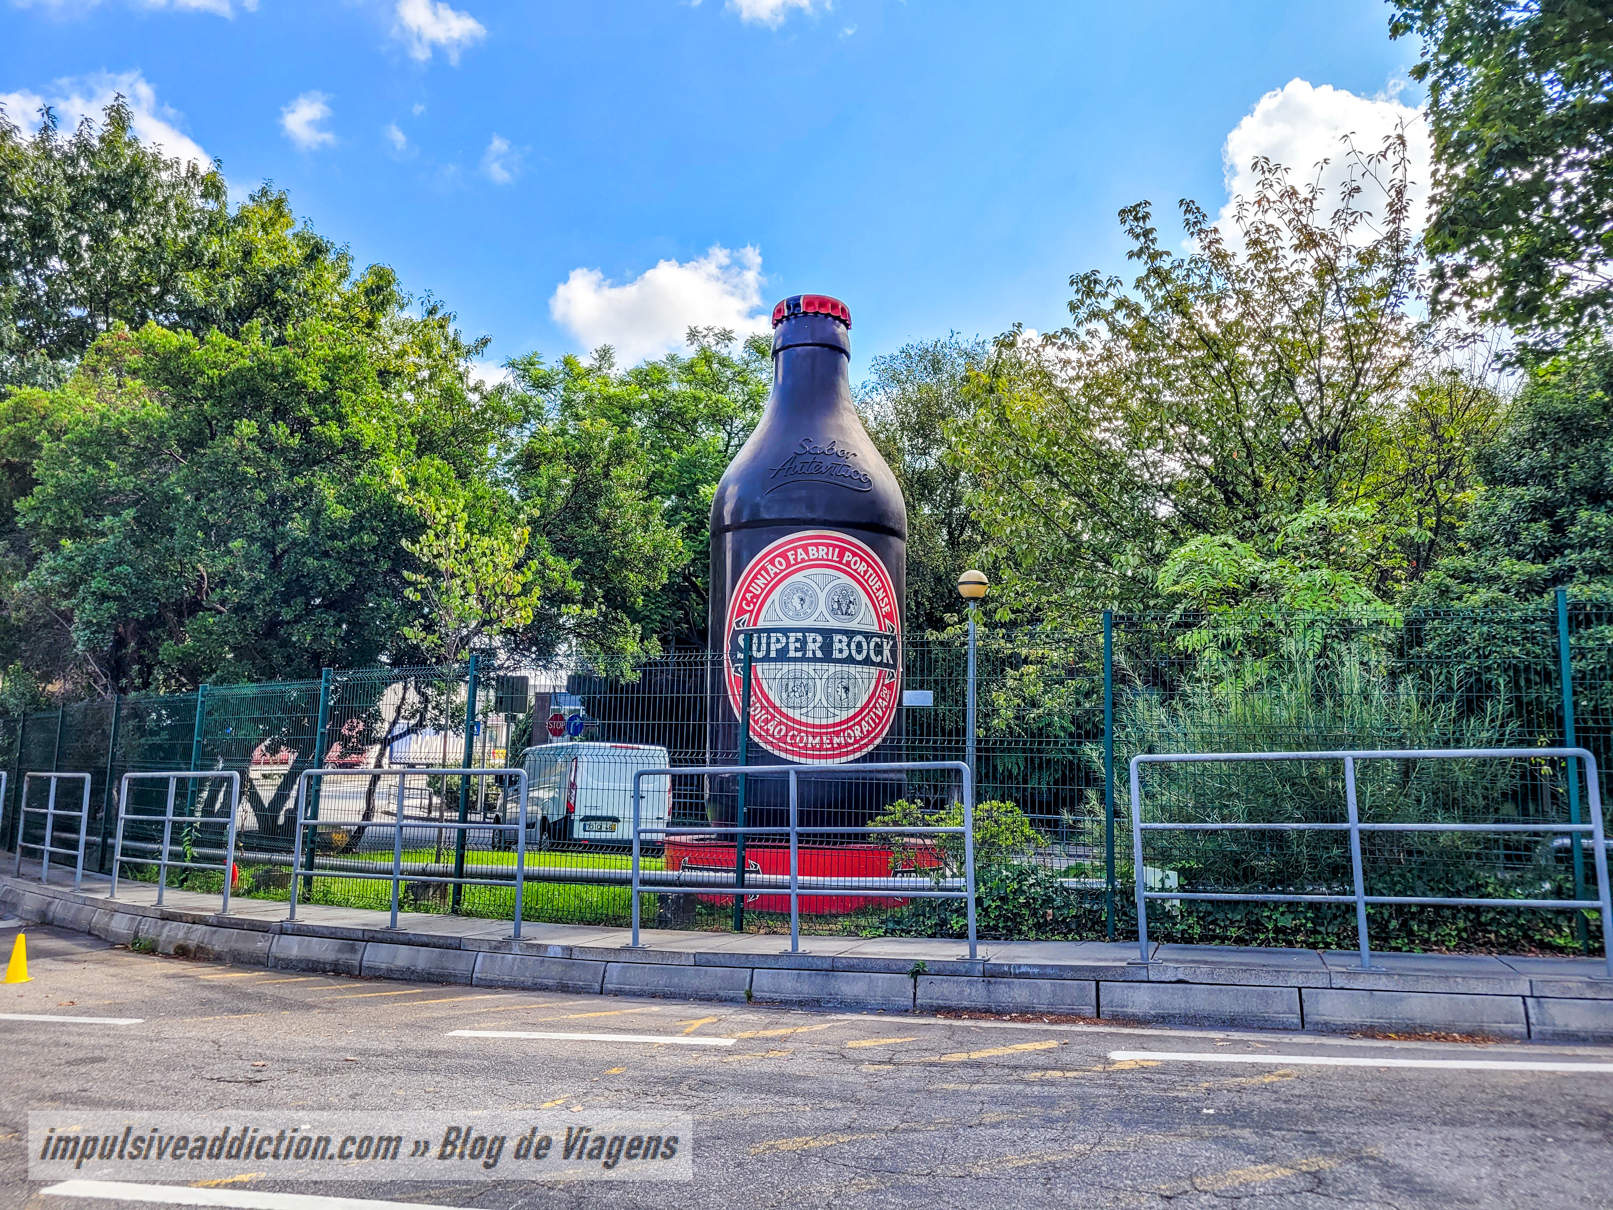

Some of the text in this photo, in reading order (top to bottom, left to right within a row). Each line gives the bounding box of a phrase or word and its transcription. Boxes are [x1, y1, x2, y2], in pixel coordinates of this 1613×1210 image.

[793, 437, 857, 459] Sabor
[749, 557, 786, 595] UNIÃO
[787, 546, 840, 564] FABRIL
[842, 551, 891, 615] PORTUENSE
[832, 634, 894, 664] BOCK
[548, 721, 566, 729] STOP
[786, 698, 888, 748] COMEMORATIVA
